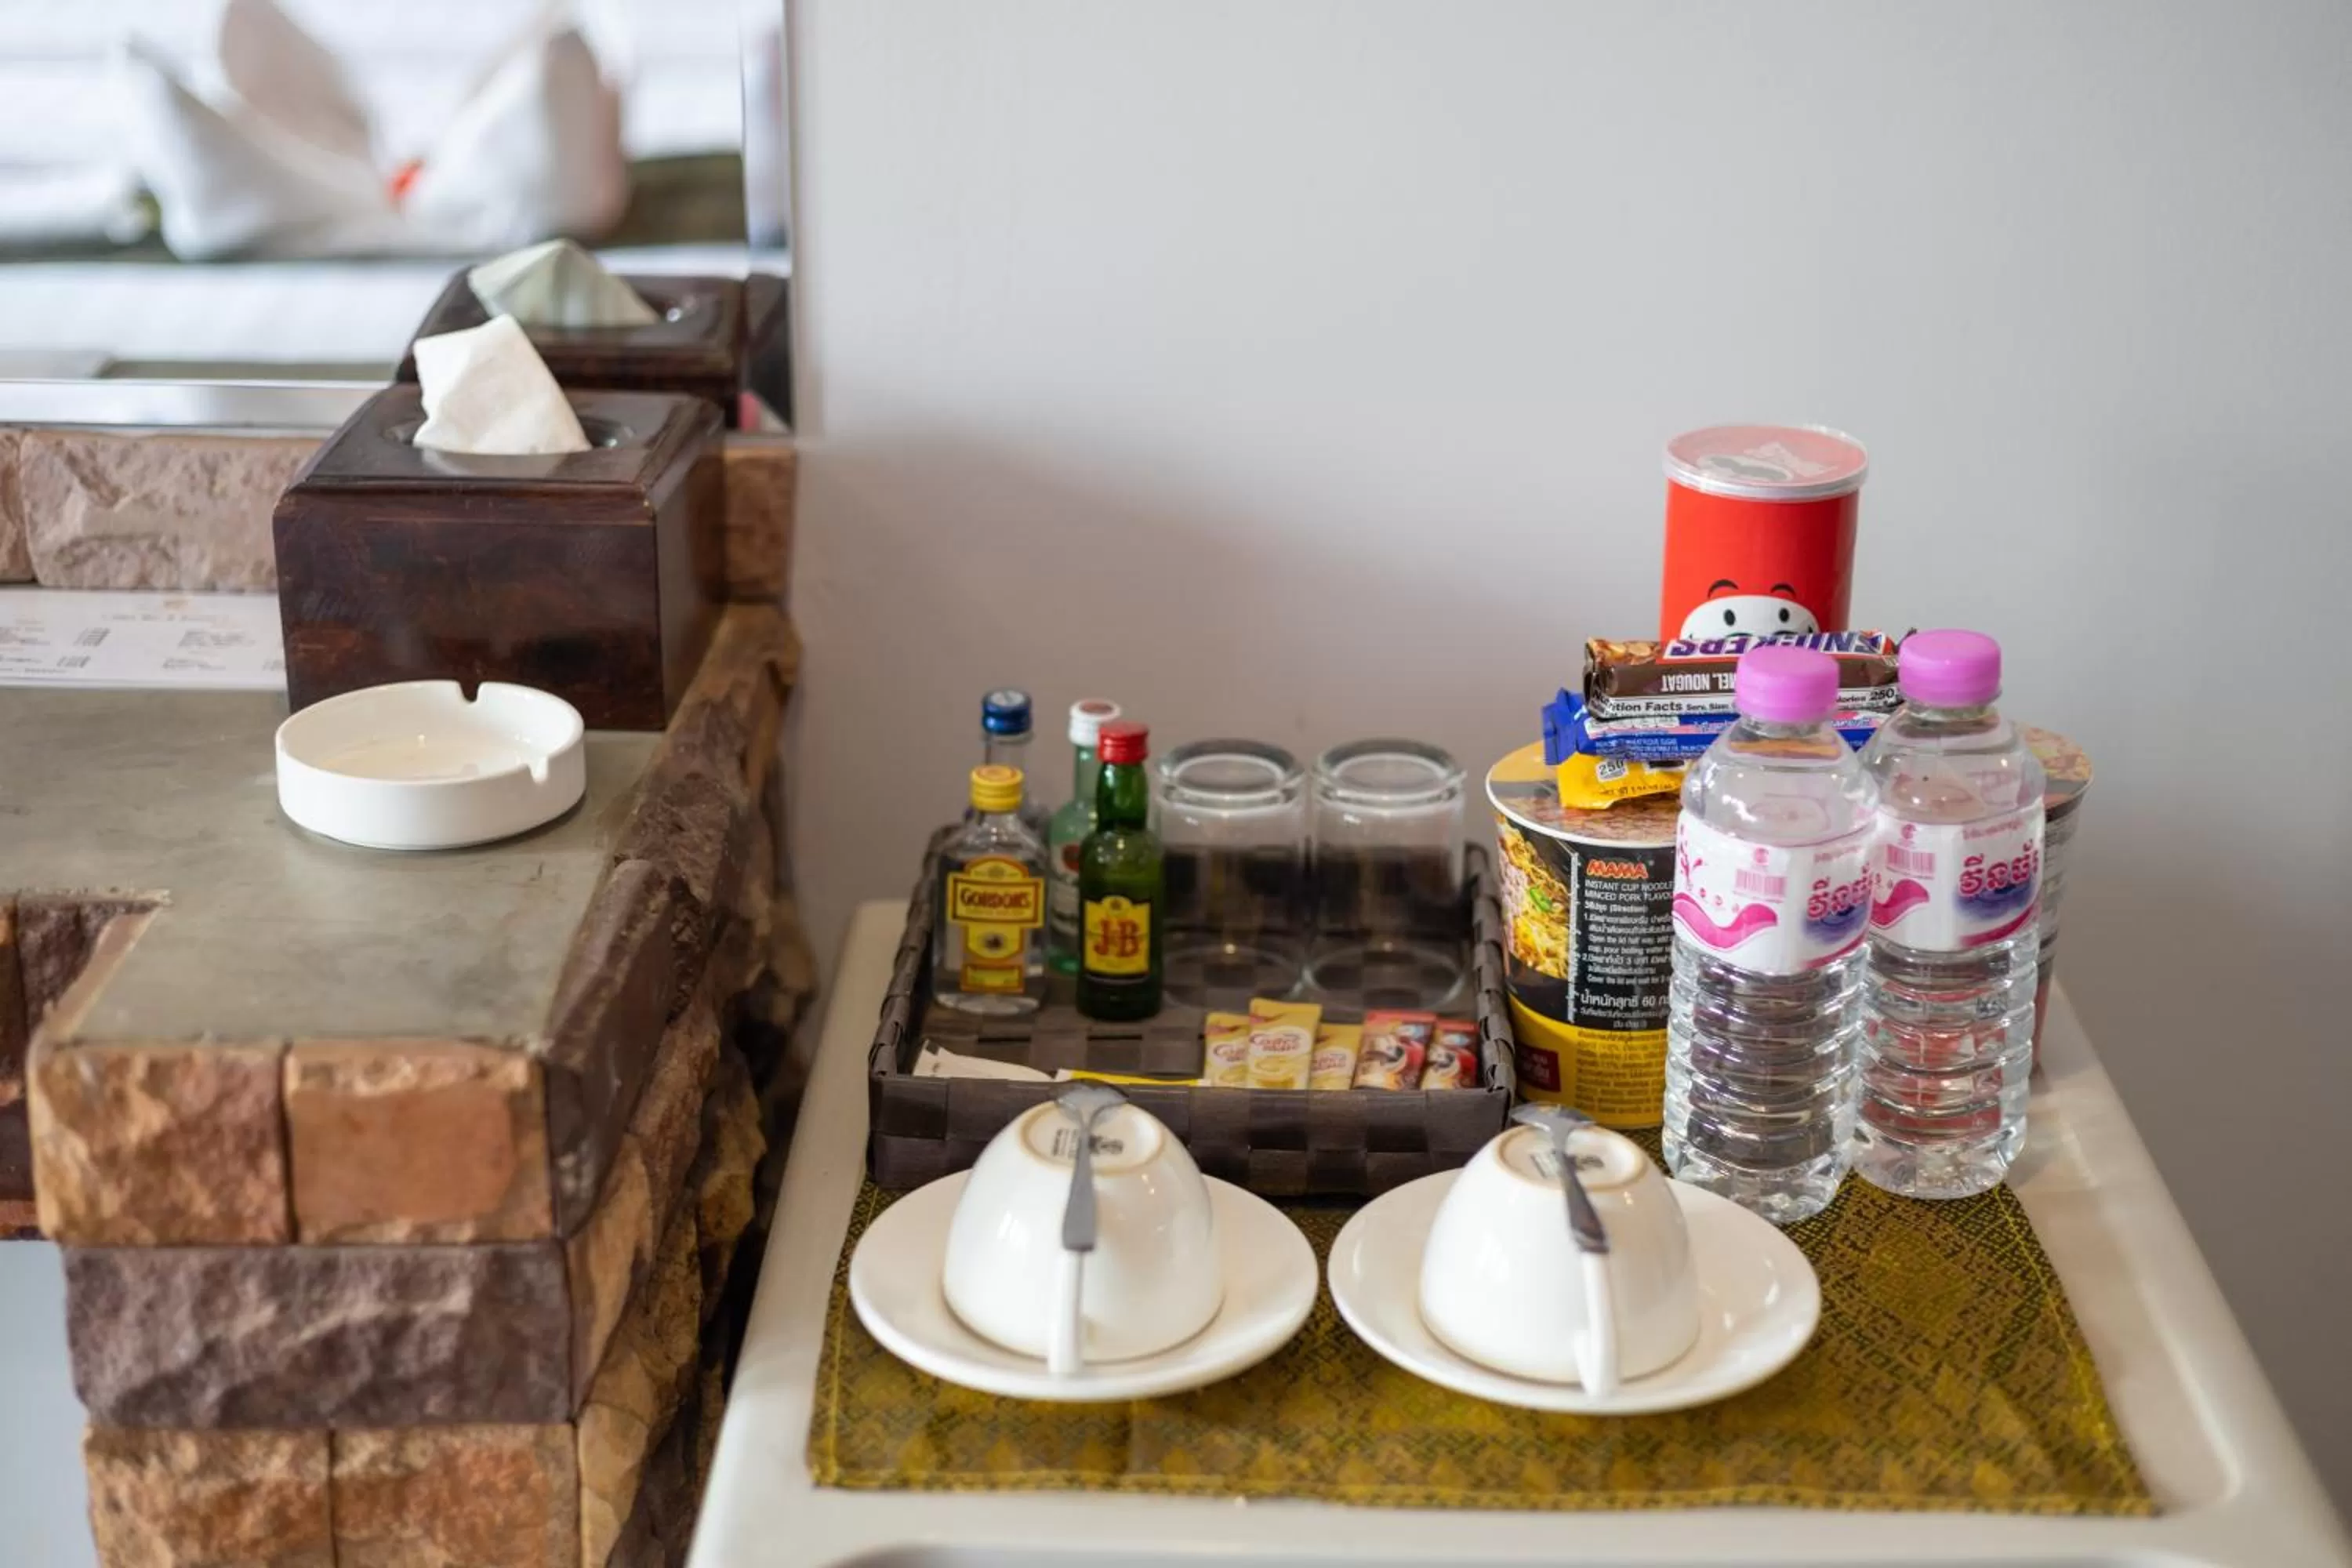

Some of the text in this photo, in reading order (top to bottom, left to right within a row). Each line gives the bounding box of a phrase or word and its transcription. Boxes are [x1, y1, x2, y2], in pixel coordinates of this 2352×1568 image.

[1661, 673, 1710, 691] NOUGAT
[1869, 688, 1895, 701] 250
[1646, 701, 1682, 711] Facts
[1599, 759, 1624, 775] 250
[1586, 858, 1649, 879] MAMA
[1584, 880, 1619, 891] INSTANT
[1621, 883, 1639, 891] CUP
[1584, 890, 1617, 901] MINCED
[1619, 892, 1641, 902] PORK
[1642, 996, 1657, 1007] 60
